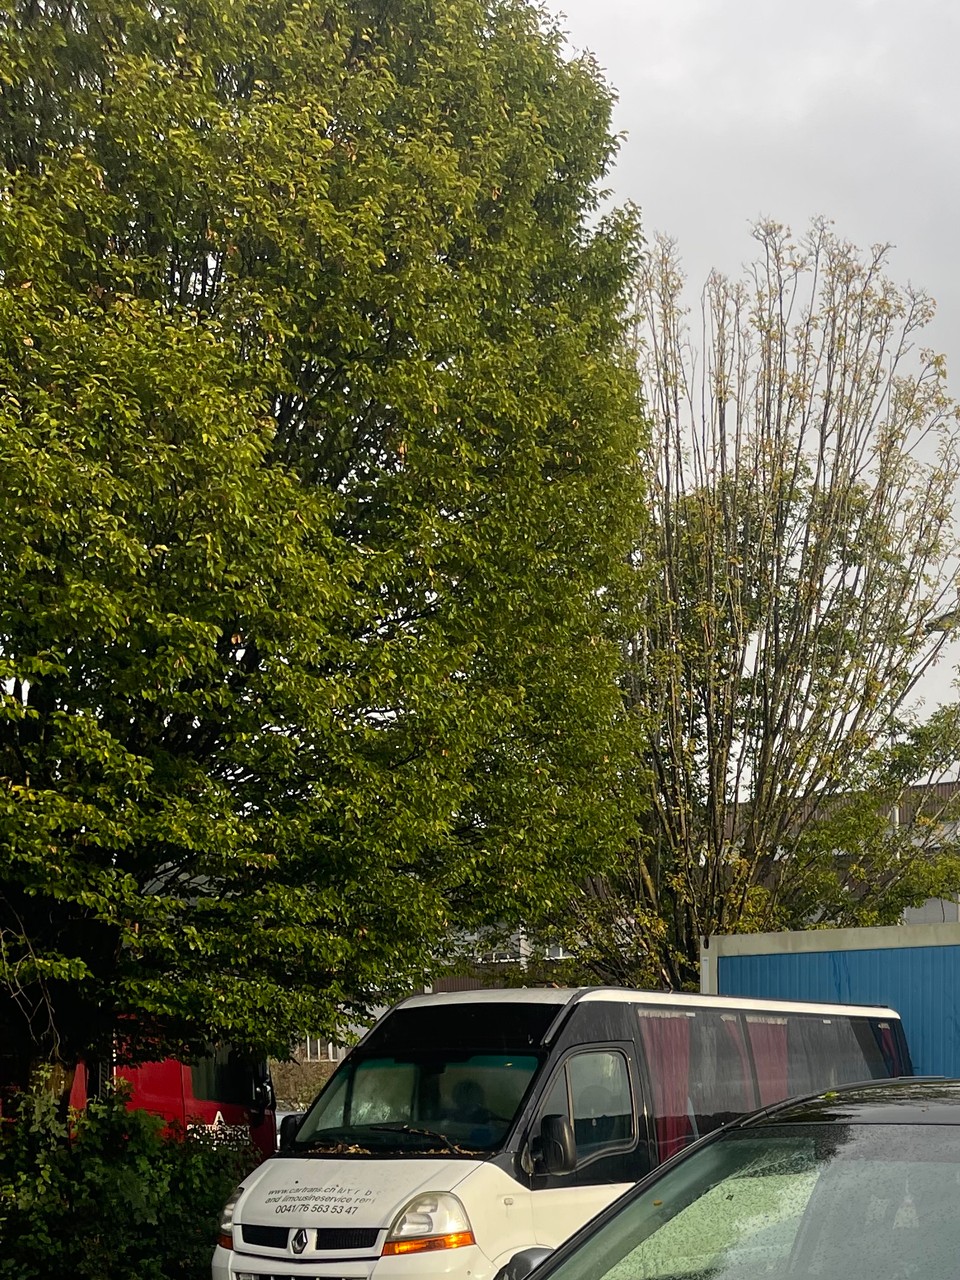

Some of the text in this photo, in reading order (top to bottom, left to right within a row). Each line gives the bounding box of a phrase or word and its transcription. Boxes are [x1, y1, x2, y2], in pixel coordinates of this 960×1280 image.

[268, 1186, 336, 1195] www.cartrans.ch
[275, 1204, 358, 1215] 0041/76 563 53 47
